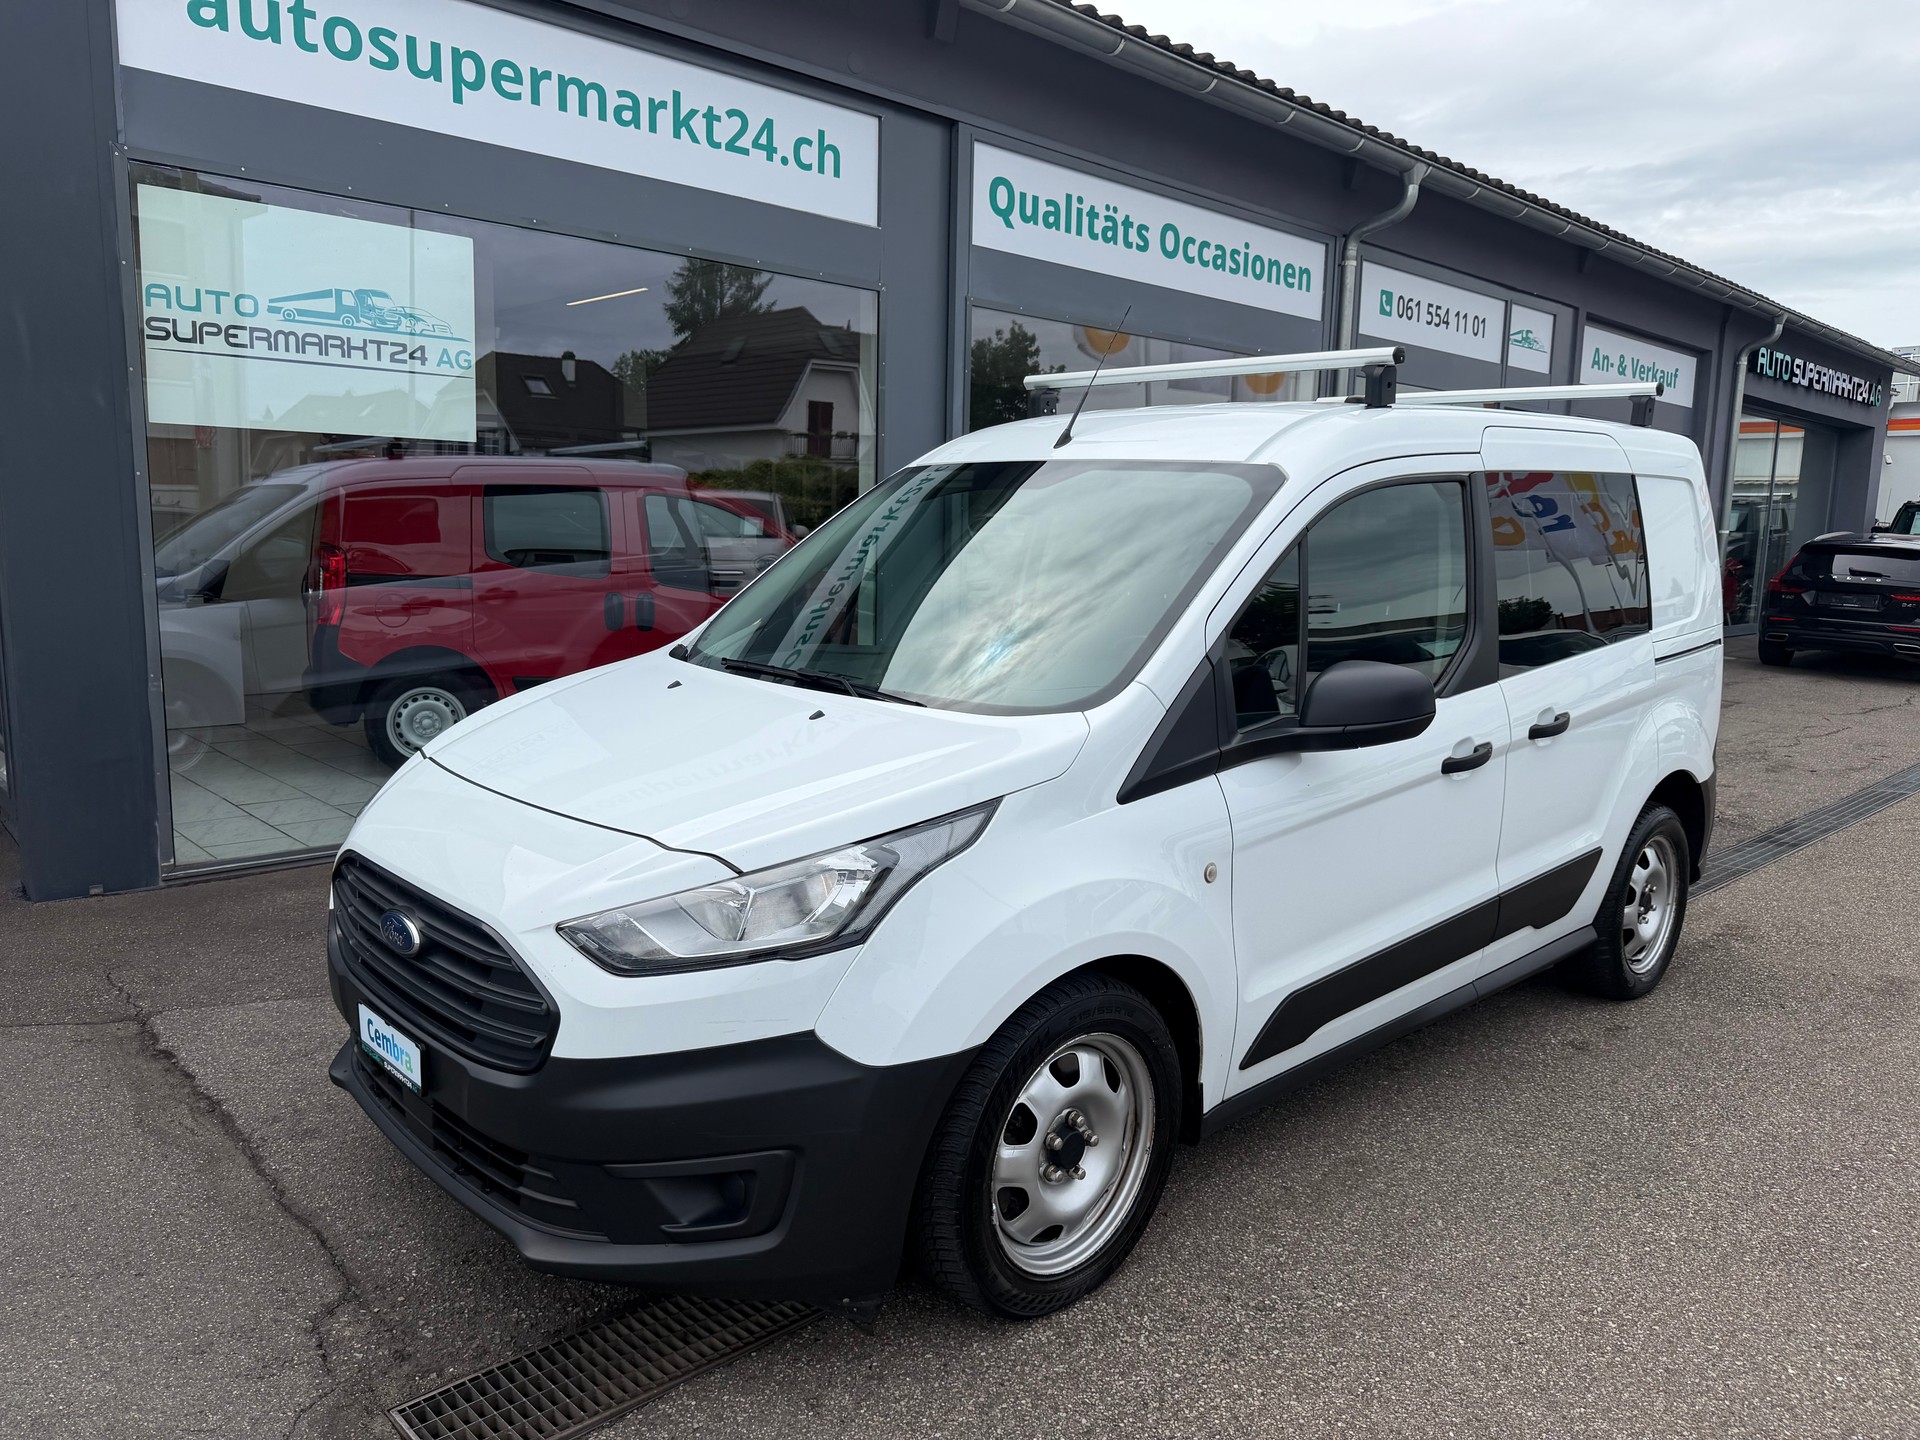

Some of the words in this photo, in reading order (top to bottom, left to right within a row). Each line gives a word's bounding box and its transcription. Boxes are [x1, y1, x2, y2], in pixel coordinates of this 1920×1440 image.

[187, 0, 842, 179] autosupermarkt24.ch
[989, 176, 1150, 253] Qualitäts
[1159, 223, 1312, 293] Occasionen
[145, 283, 259, 318] AUTO
[1396, 295, 1421, 324] 061
[1425, 303, 1450, 330] 554
[1454, 311, 1468, 334] 11
[1472, 315, 1487, 339] 01
[145, 316, 428, 366] SUPERMARKT24
[436, 348, 472, 371] AG
[1591, 347, 1614, 372] An-
[1617, 354, 1627, 377] &
[1631, 357, 1679, 389] Verkauf
[1757, 347, 1791, 381] AUTO
[1792, 358, 1870, 404] SUPERMARKT24
[1869, 382, 1882, 408] AG
[384, 917, 408, 947] Ford
[367, 1017, 413, 1074] Cembra
